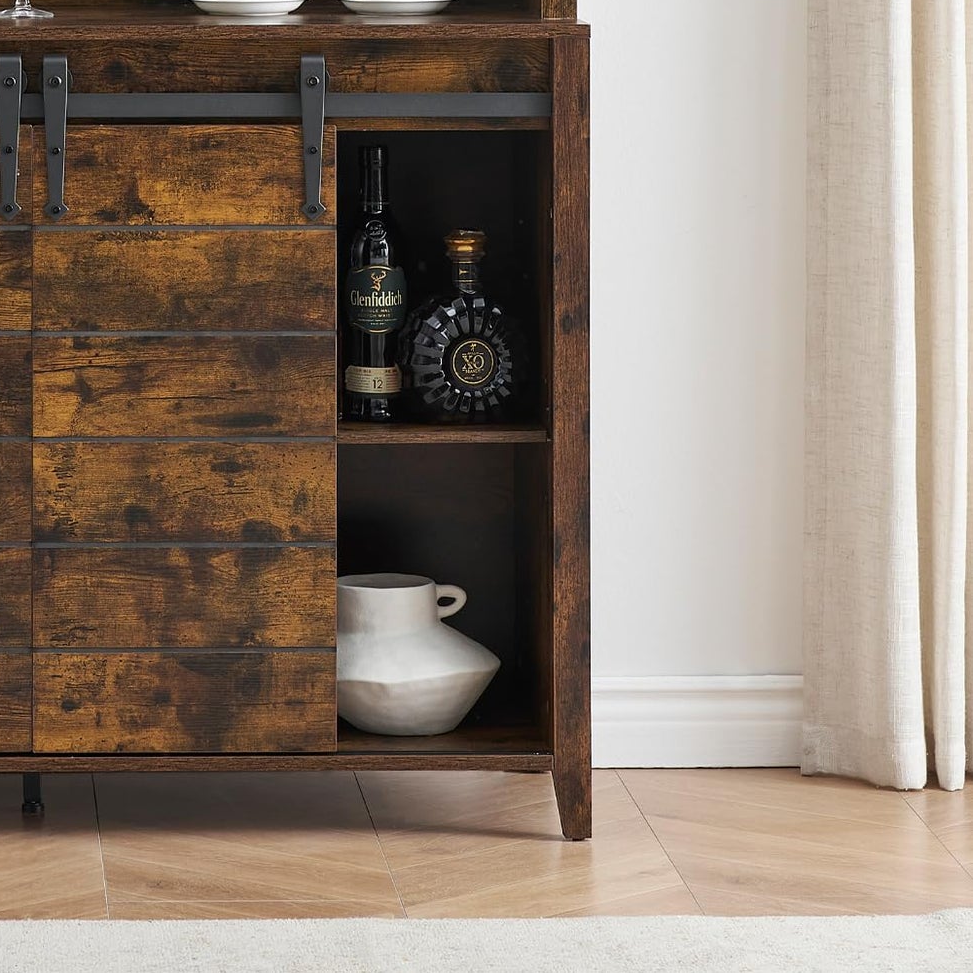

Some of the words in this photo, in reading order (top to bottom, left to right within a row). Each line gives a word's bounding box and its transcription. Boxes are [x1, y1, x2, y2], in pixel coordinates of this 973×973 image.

[350, 289, 402, 307] Glenfiddich
[461, 354, 485, 370] XO
[372, 379, 383, 389] 12
